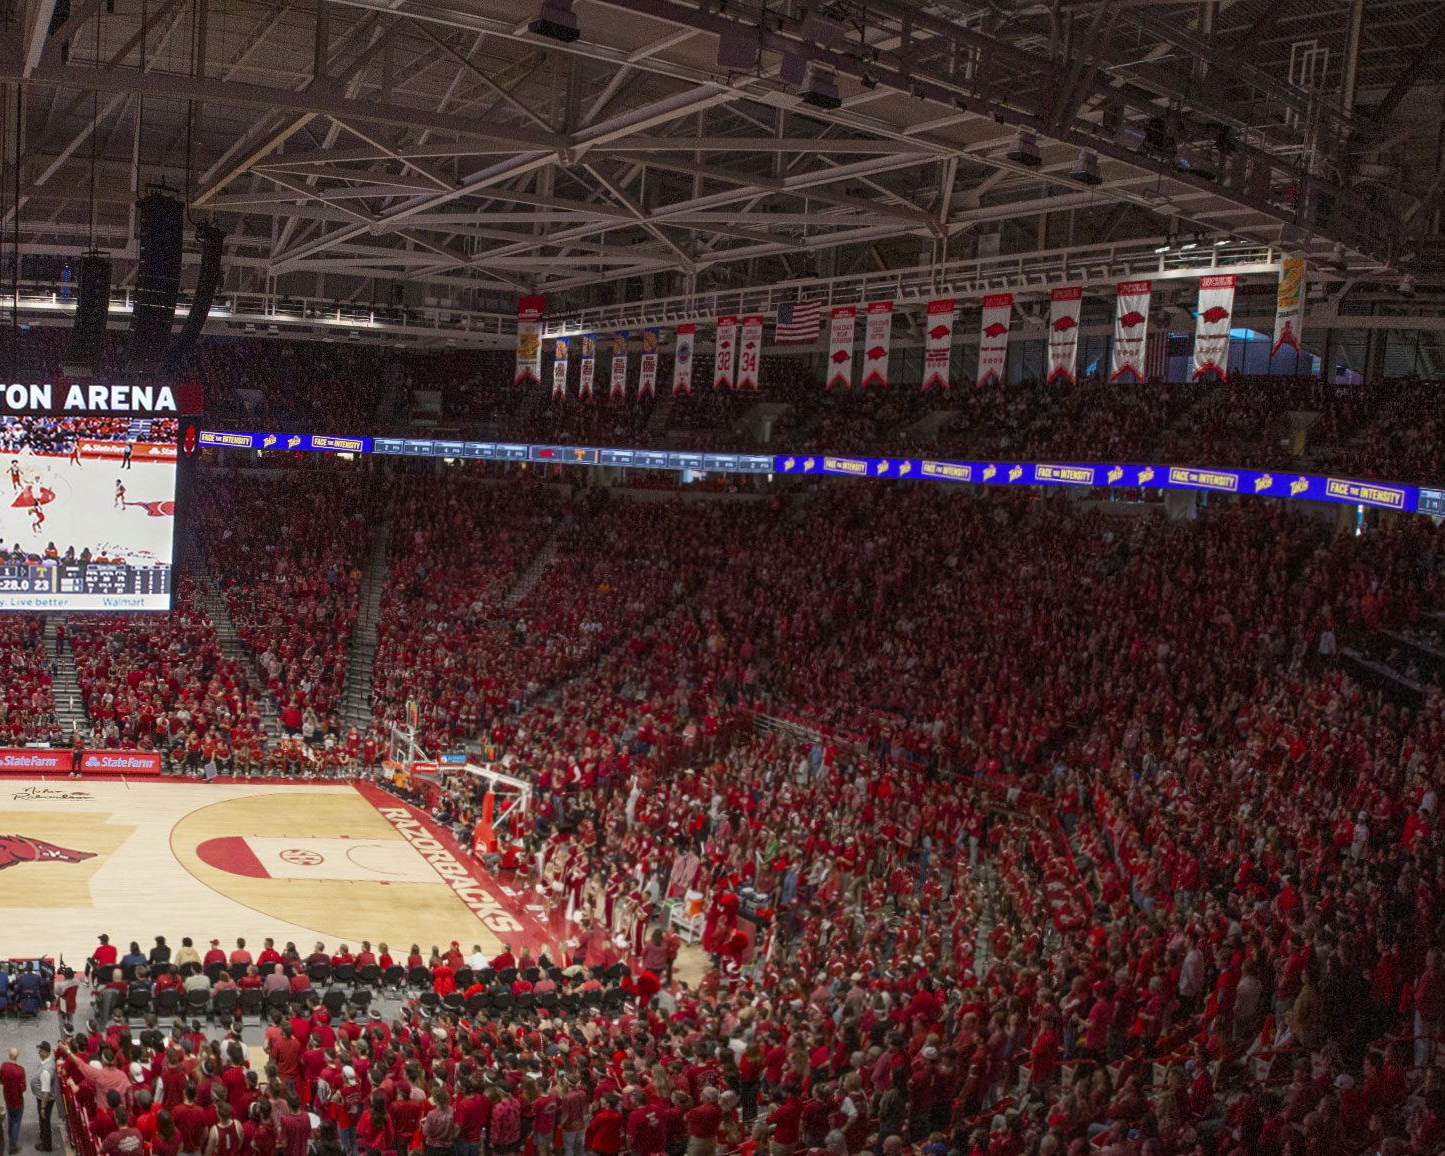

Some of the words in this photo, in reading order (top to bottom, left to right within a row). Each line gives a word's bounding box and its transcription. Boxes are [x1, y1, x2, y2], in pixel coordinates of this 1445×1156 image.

[718, 352, 731, 370] 32
[742, 352, 755, 372] 34
[64, 384, 177, 411] ARENA
[202, 433, 215, 442] FACE
[222, 435, 250, 445] INTENSITY
[314, 438, 327, 446] FACE
[334, 440, 361, 450] INTENSITY
[826, 460, 836, 468] FACE
[842, 462, 864, 472] INTENSITY
[924, 464, 936, 473] FACE
[943, 466, 969, 477] INTENSITY
[1038, 467, 1052, 477] FACE
[1060, 470, 1090, 481] INTENSITY
[1172, 470, 1188, 482] FACE
[1198, 474, 1235, 488] INTENSITY
[1255, 477, 1273, 493] Takis
[1291, 480, 1309, 496] Takis
[1330, 482, 1349, 495] FACE
[1350, 487, 1359, 495] THE
[1360, 486, 1402, 504] INTENSITY
[34, 580, 50, 590] 23
[11, 598, 32, 606] Live
[103, 598, 145, 606] Walmart
[379, 807, 523, 933] RAZORBACKS
